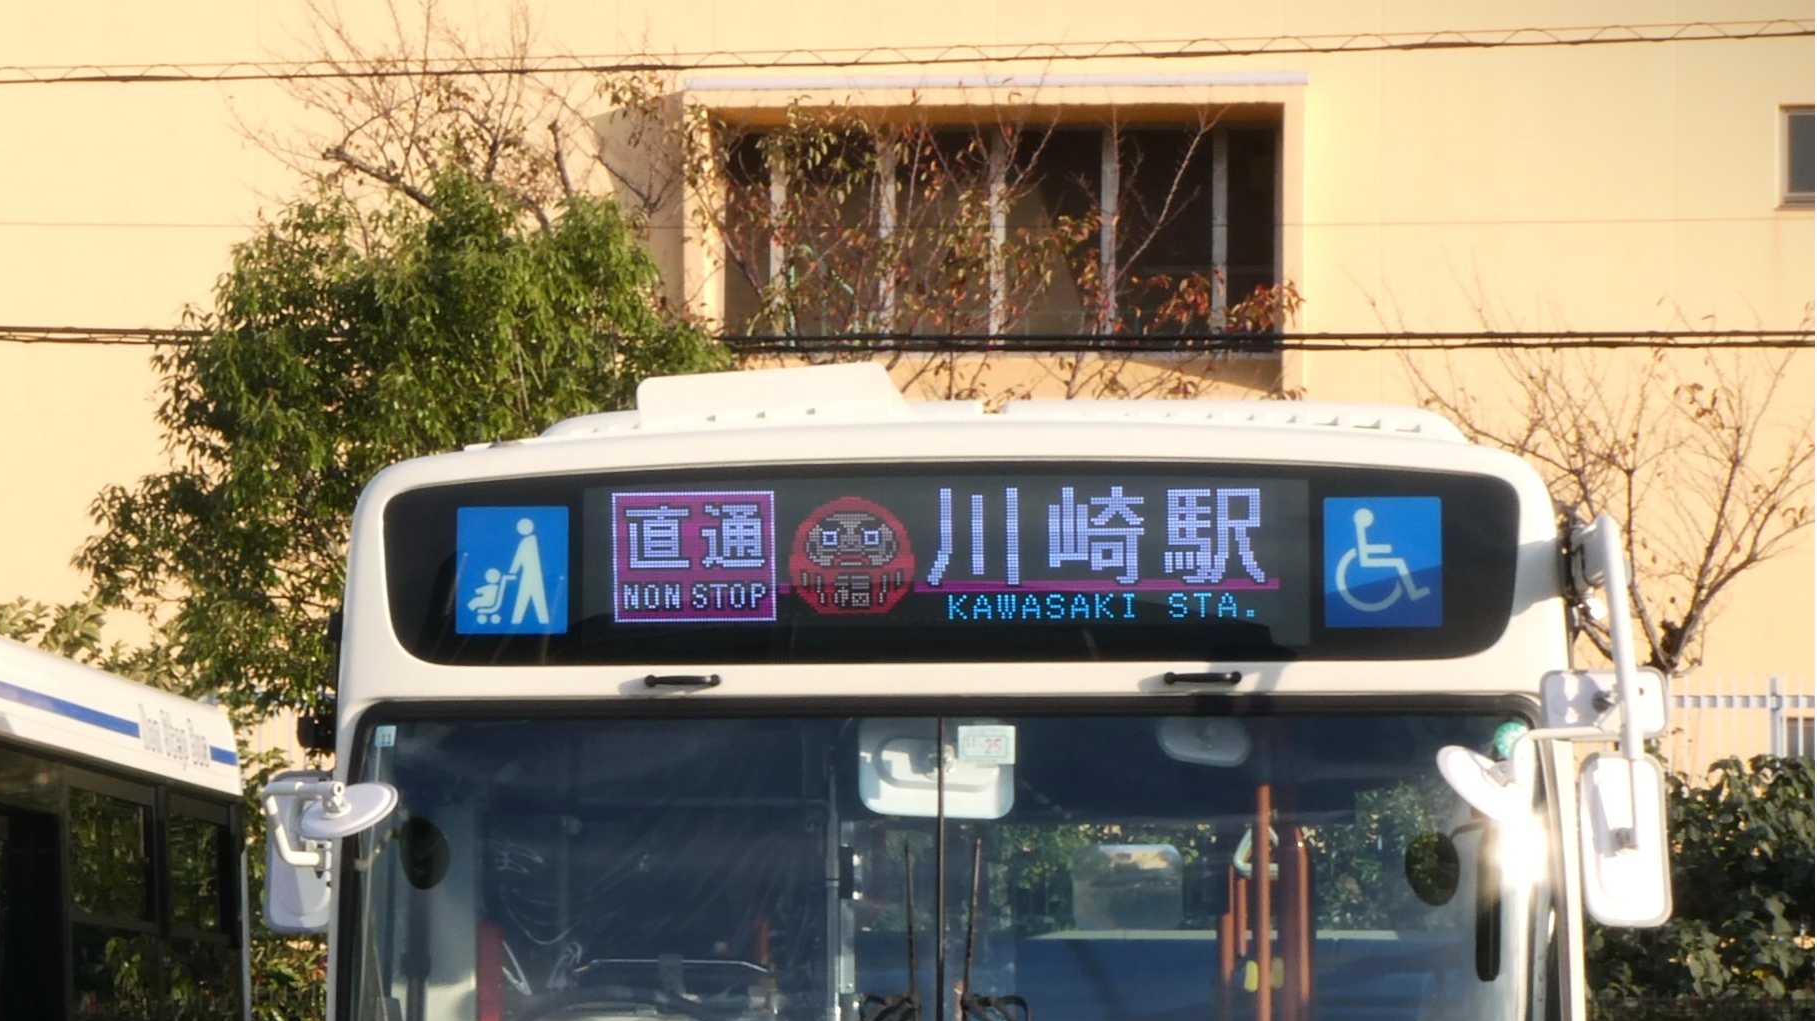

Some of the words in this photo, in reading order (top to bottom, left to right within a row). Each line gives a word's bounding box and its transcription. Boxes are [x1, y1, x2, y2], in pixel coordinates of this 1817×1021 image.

[625, 504, 765, 568] 直通
[927, 486, 1265, 587] 川崎駅
[623, 583, 680, 610] NON
[691, 583, 767, 609] STOP
[948, 592, 1136, 620] KAWASAKI
[1168, 592, 1257, 619] STA.
